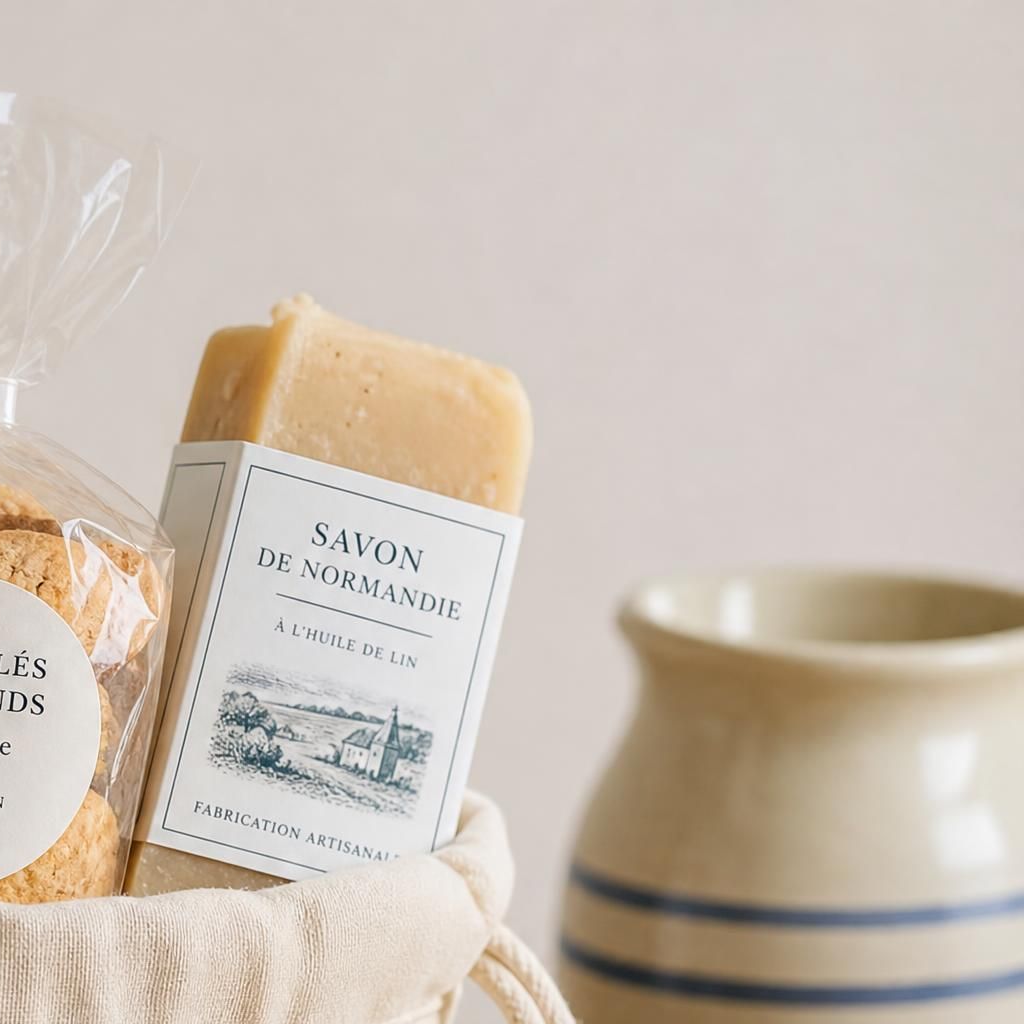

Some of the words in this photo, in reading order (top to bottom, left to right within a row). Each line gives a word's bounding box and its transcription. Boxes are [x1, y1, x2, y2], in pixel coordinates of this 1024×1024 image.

[311, 521, 424, 574] SAVON
[257, 547, 293, 573] DE
[300, 558, 462, 620] NORMANDIE
[274, 617, 286, 633] À
[292, 624, 357, 652] L'HUILE
[362, 643, 385, 660] DE
[390, 650, 419, 669] LIN
[193, 800, 301, 840] FABRICATION
[305, 832, 400, 862] ARTISANAL
